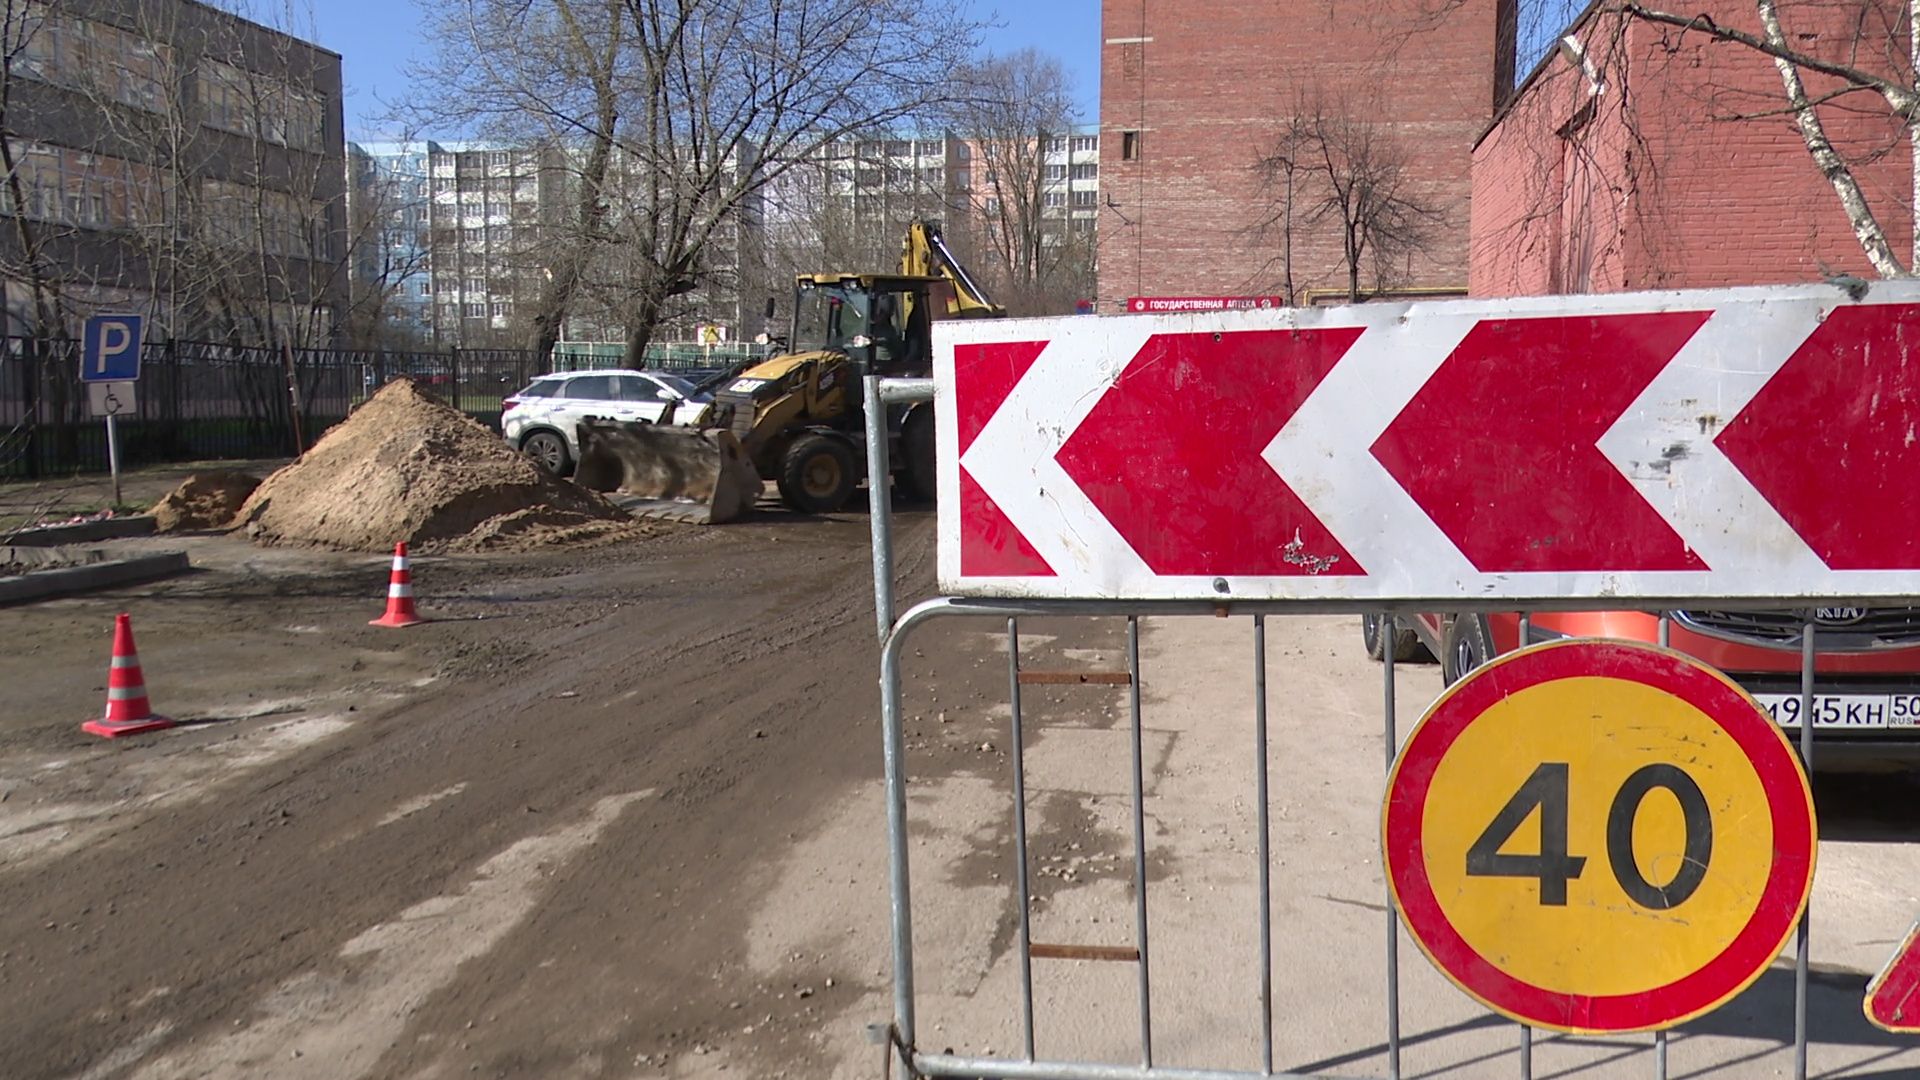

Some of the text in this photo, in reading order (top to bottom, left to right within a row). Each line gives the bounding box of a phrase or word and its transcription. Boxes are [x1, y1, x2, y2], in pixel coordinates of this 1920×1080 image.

[1150, 299, 1256, 310] ГОСУДАРСТВЕННАЯ АПТЕКА
[97, 322, 131, 374] P
[1816, 607, 1858, 619] KIA
[1891, 717, 1912, 725] RUS
[1466, 763, 1713, 910] 40
